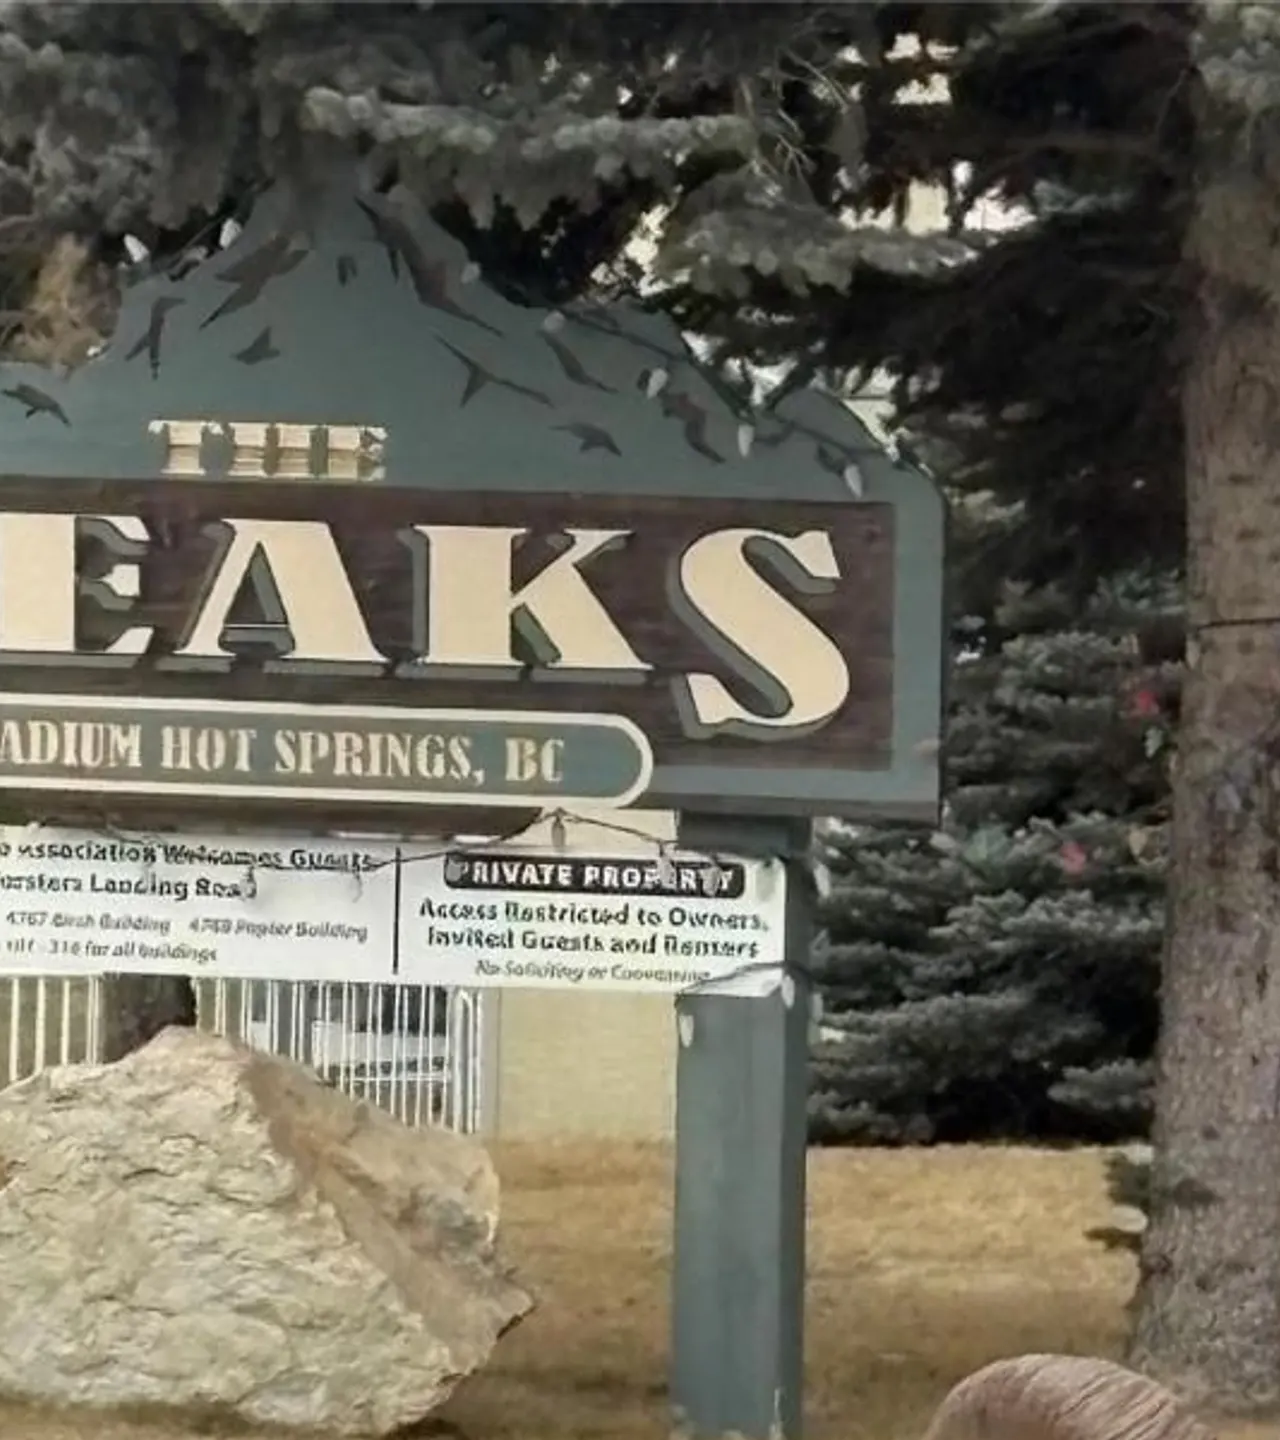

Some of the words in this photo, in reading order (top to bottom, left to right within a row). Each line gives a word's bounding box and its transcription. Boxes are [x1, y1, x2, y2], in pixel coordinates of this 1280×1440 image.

[148, 419, 388, 481] THE
[161, 725, 257, 771] HOT
[274, 729, 484, 783] SPRINGS,
[505, 737, 564, 782] BC
[290, 849, 372, 872] Guests
[90, 873, 188, 901] Landing
[420, 898, 497, 920] Access
[505, 901, 629, 926] Restricted
[637, 908, 663, 926] to
[99, 914, 171, 936] Building
[296, 921, 368, 944] Building
[428, 926, 515, 949] Invited
[522, 930, 605, 952] Guests
[611, 934, 657, 954] and
[664, 934, 760, 958] Renters
[84, 940, 109, 956] for
[111, 941, 135, 958] all
[138, 943, 218, 964] buildings
[588, 966, 608, 980] or
